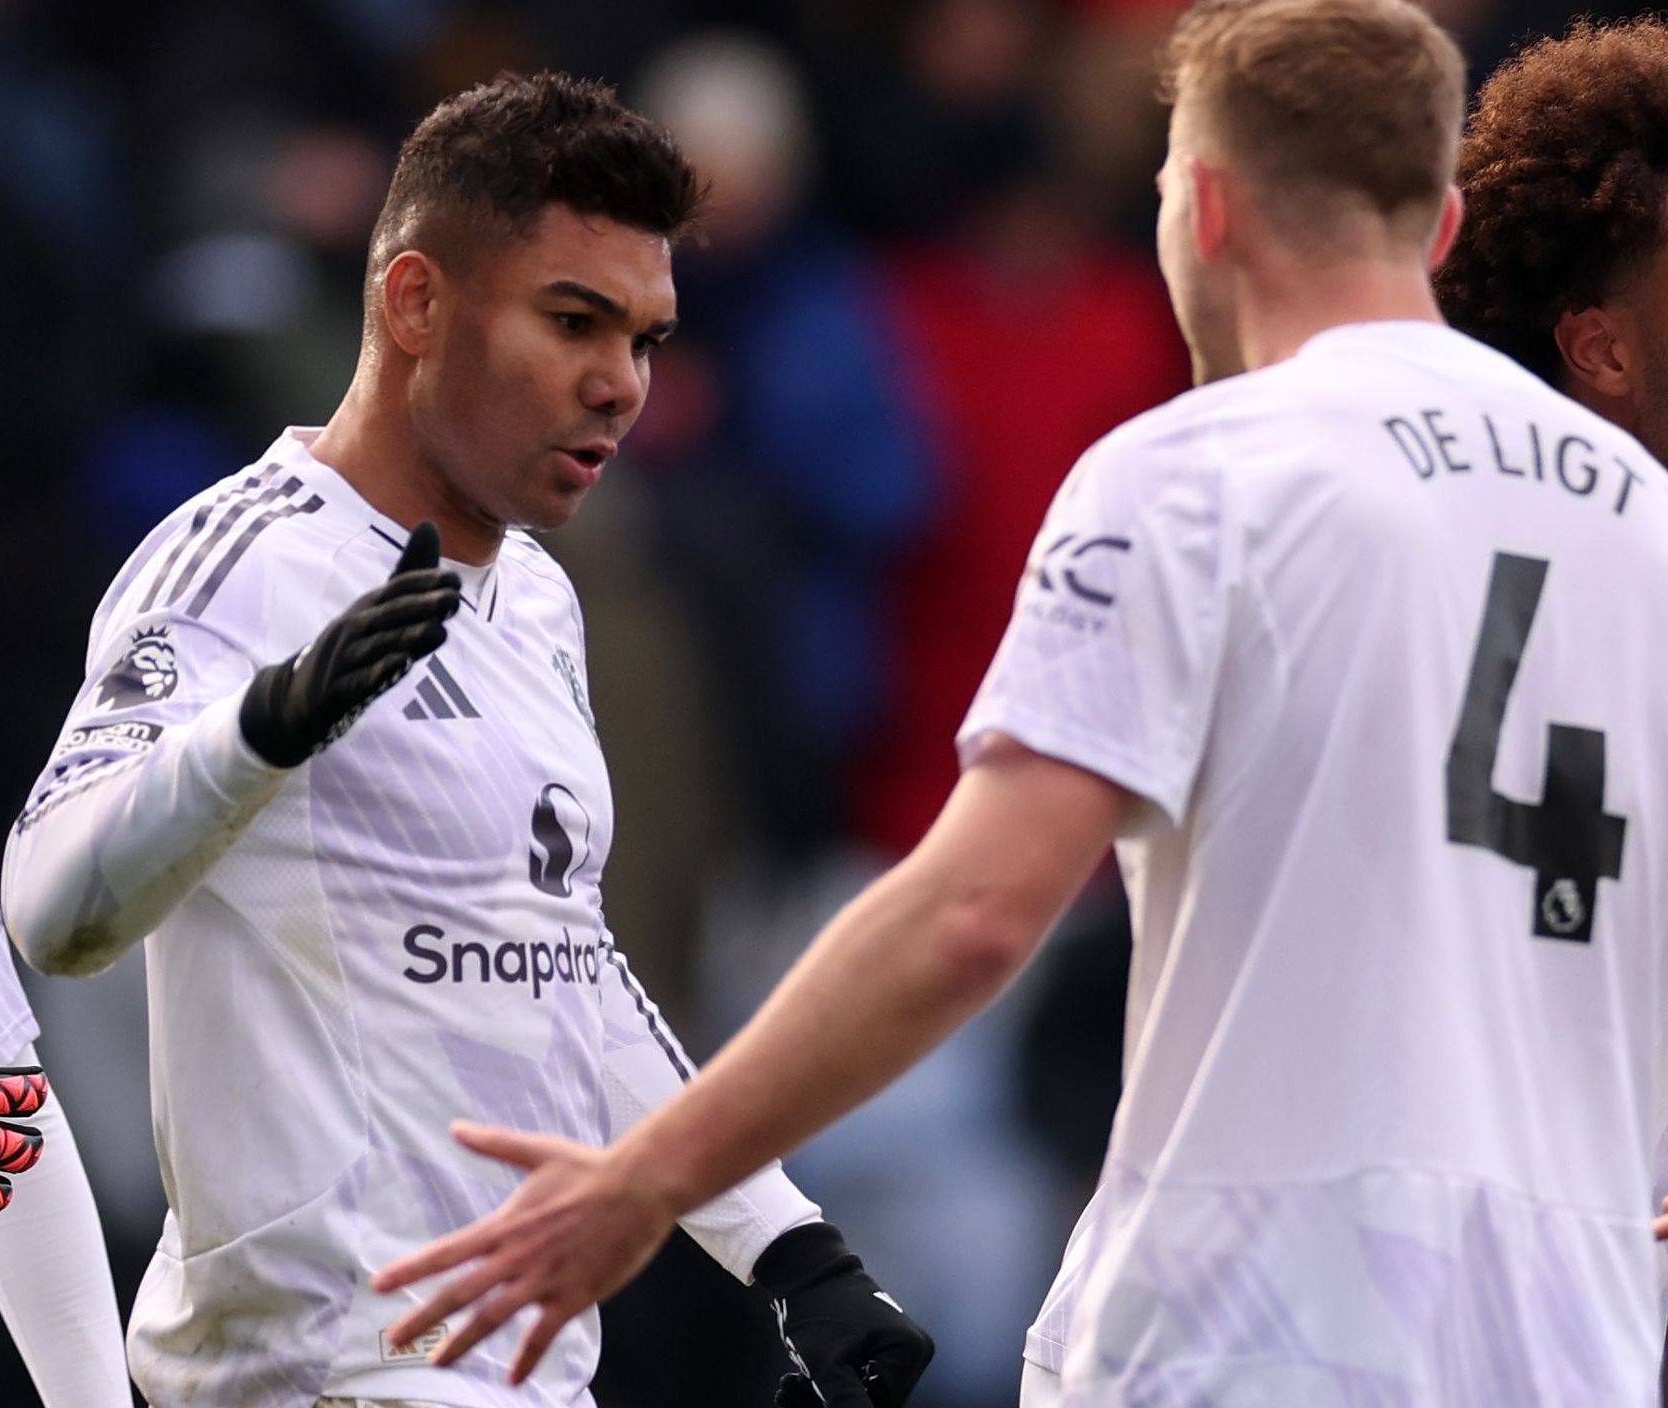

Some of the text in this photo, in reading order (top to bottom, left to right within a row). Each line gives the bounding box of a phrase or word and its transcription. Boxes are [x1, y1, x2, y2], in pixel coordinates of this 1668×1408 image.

[1383, 408, 1645, 517] DE LIGT
[1444, 551, 1629, 944] 4
[403, 925, 603, 1004] Snapdra
